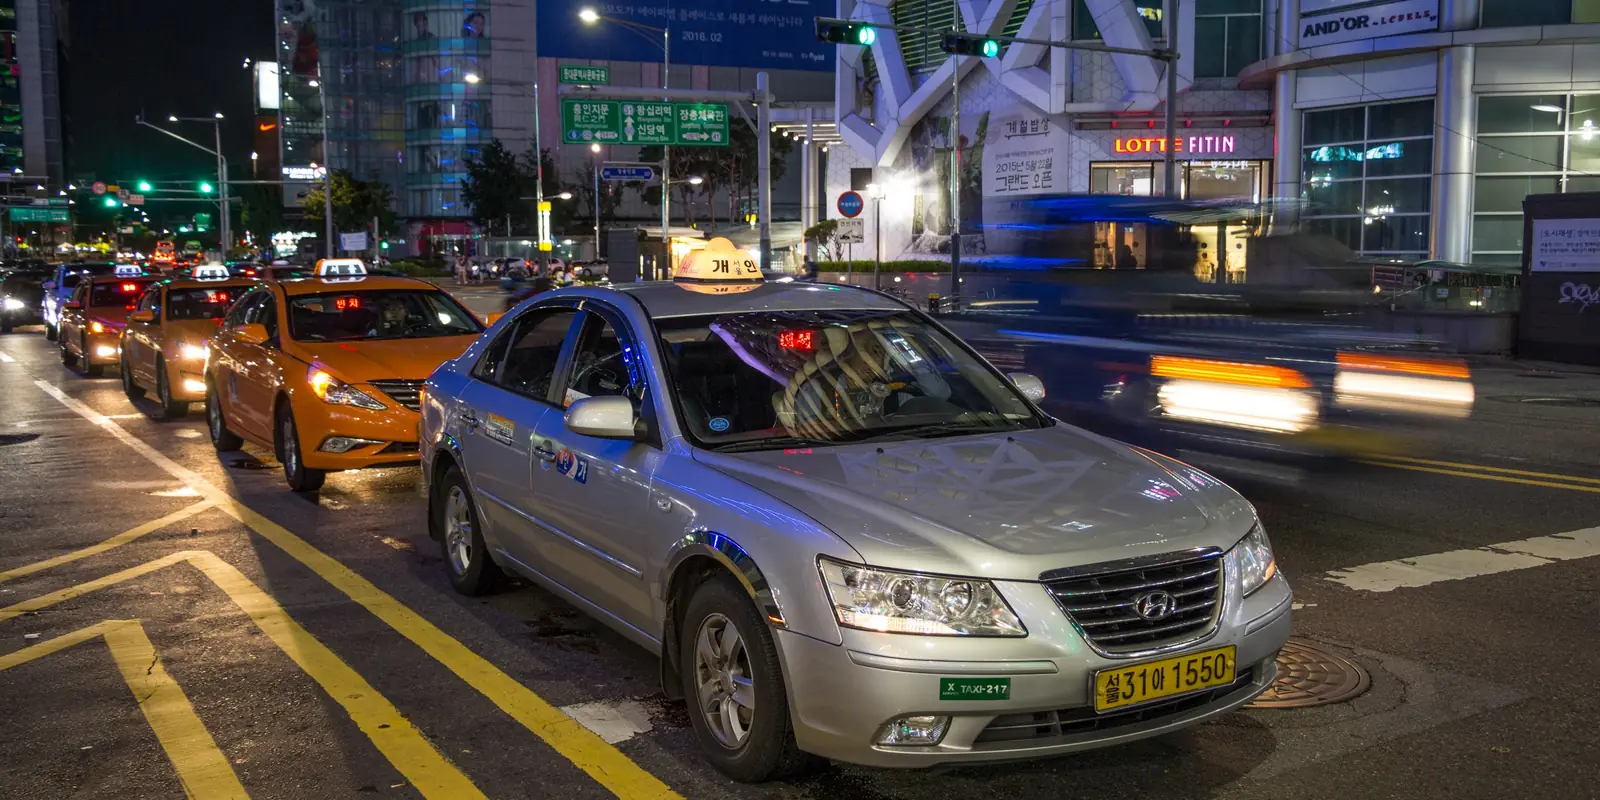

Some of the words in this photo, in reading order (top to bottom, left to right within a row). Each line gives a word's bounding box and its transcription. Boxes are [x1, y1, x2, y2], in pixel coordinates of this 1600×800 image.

[1303, 15, 1369, 38] AND'OR
[682, 31, 708, 41] 2016.
[710, 33, 722, 42] 02
[637, 104, 672, 116] 왕십리역
[680, 109, 724, 121] 장충체육관
[638, 124, 665, 135] 신당역
[1006, 117, 1050, 133] 계절밥상
[1114, 137, 1183, 153] LOTTE
[1189, 136, 1234, 153] FITIN
[995, 161, 1024, 173] 2015년
[995, 173, 1029, 192] 그랜드
[1032, 171, 1052, 188] 오픈
[1106, 673, 1120, 704] 서울
[1122, 667, 1165, 700] 31아
[1172, 653, 1226, 690] 1550
[947, 683, 955, 691] X
[960, 685, 1008, 694] TAXI-217
